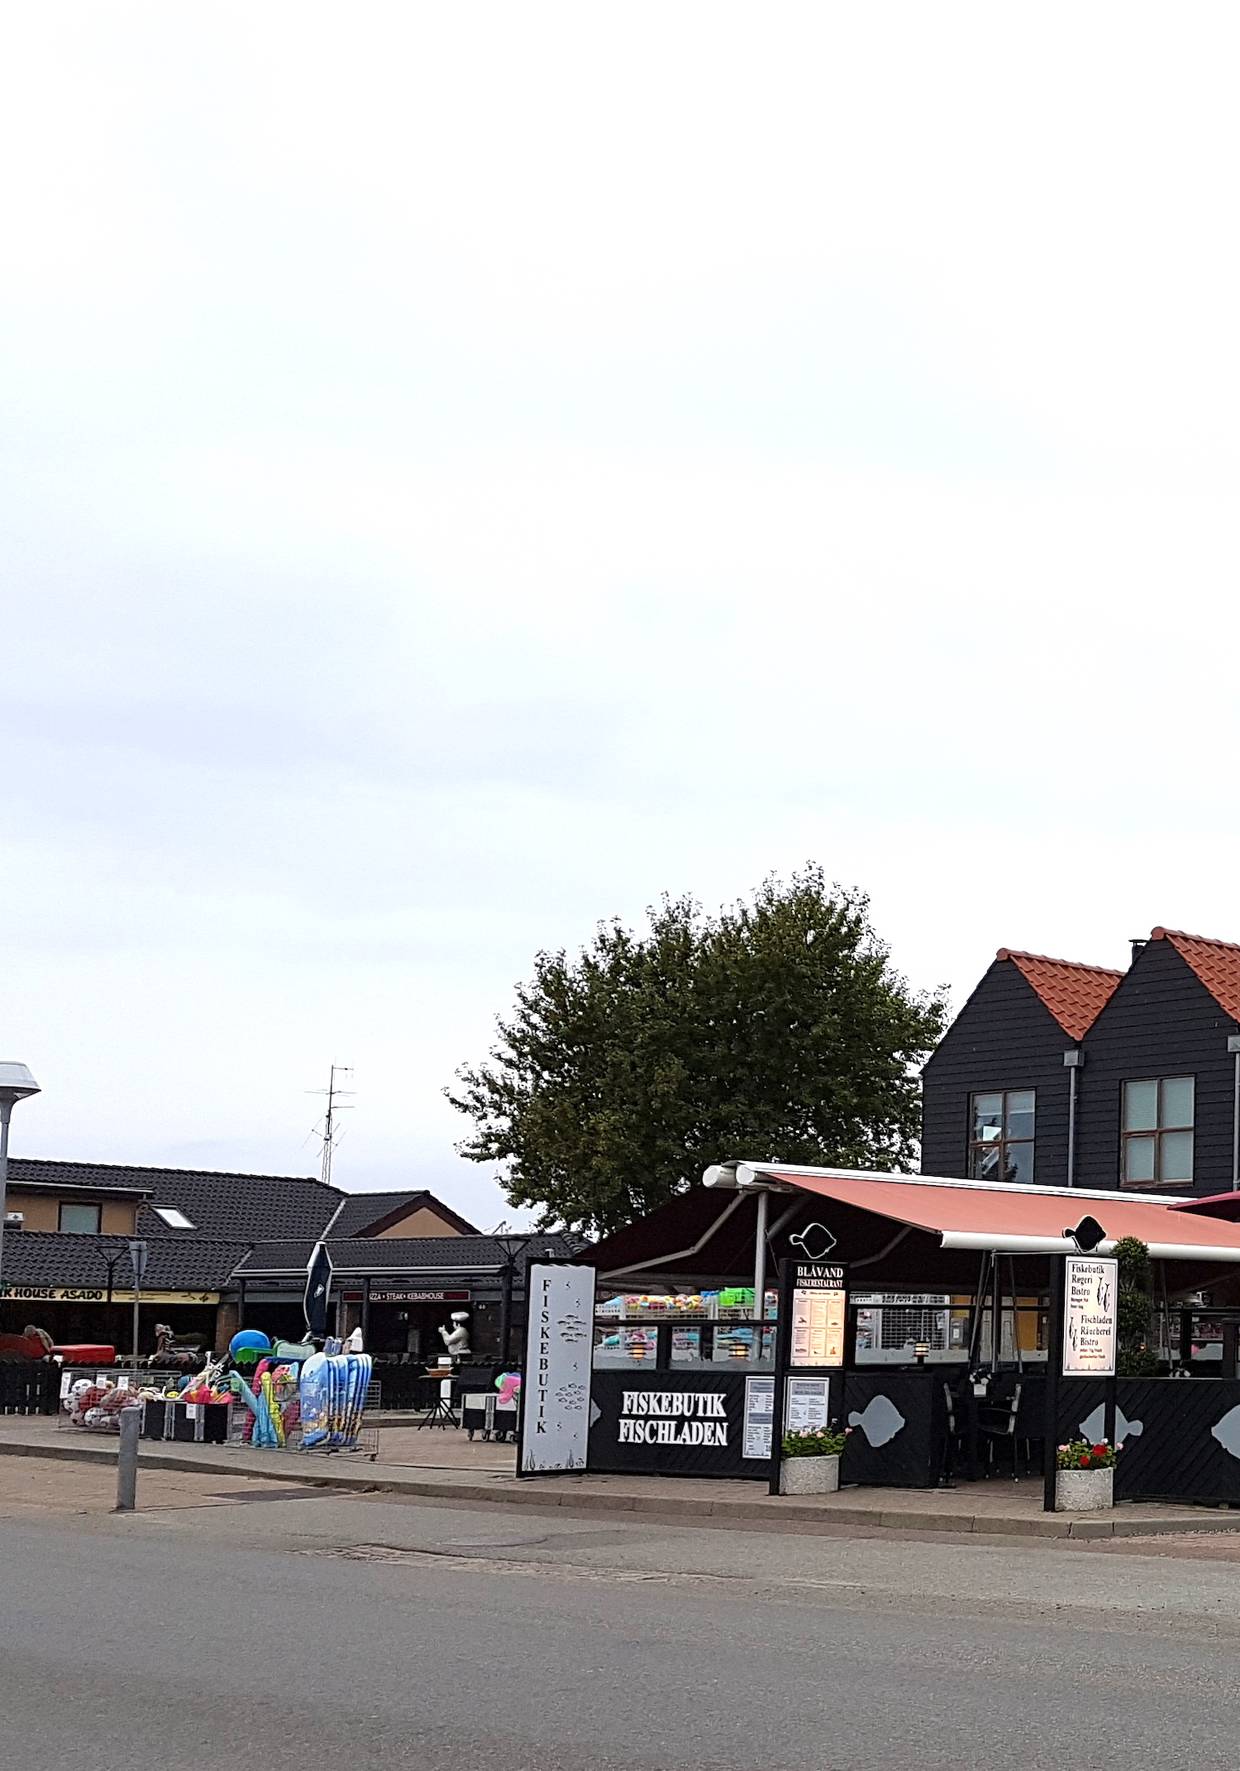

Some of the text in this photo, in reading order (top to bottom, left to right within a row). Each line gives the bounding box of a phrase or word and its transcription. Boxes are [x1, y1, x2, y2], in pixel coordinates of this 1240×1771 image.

[797, 1264, 844, 1278] BLÅVAND
[60, 1291, 103, 1300] ASADO
[536, 1279, 551, 1434] FISKEBUTIK
[621, 1391, 727, 1418] FISKEBUTIK
[618, 1419, 728, 1447] FISCHLADEN
